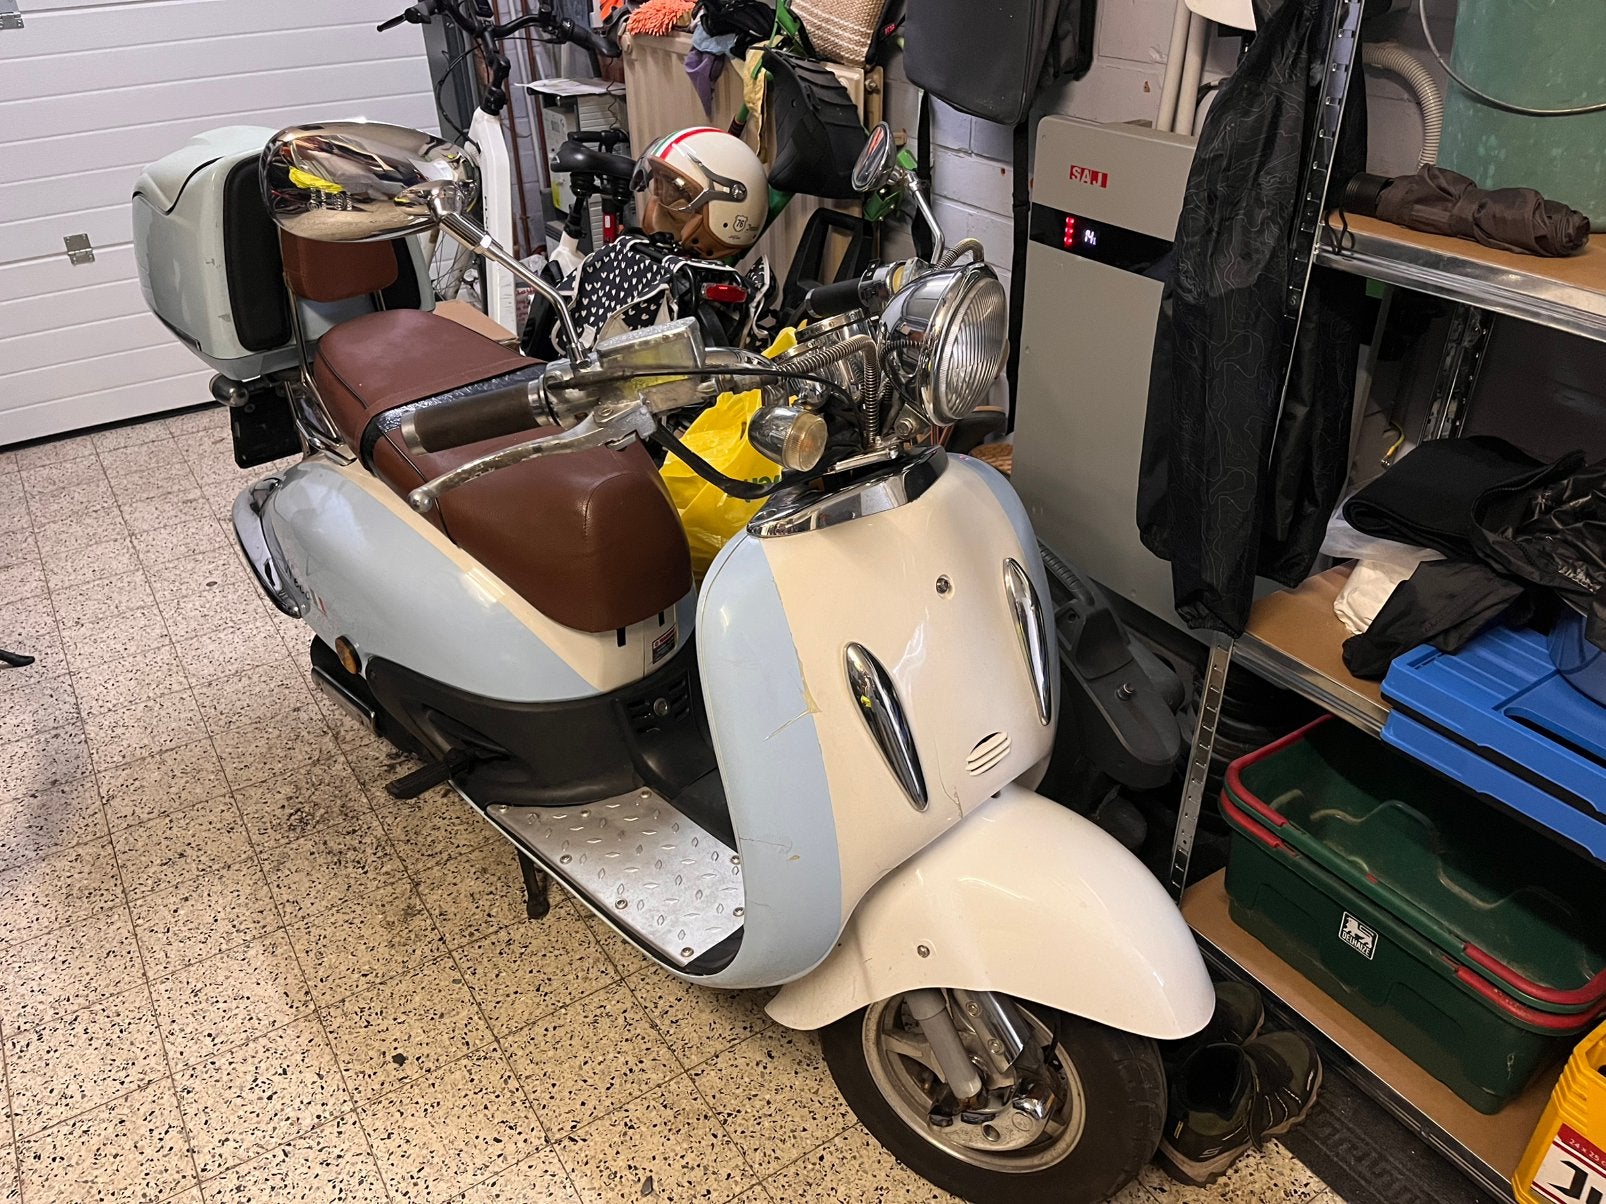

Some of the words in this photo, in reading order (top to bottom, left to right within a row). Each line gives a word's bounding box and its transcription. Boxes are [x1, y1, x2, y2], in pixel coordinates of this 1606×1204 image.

[1071, 166, 1104, 188] SAJ
[1341, 931, 1370, 957] DELHAIZE
[1569, 1138, 1580, 1149] 24
[1588, 1151, 1600, 1161] 25
